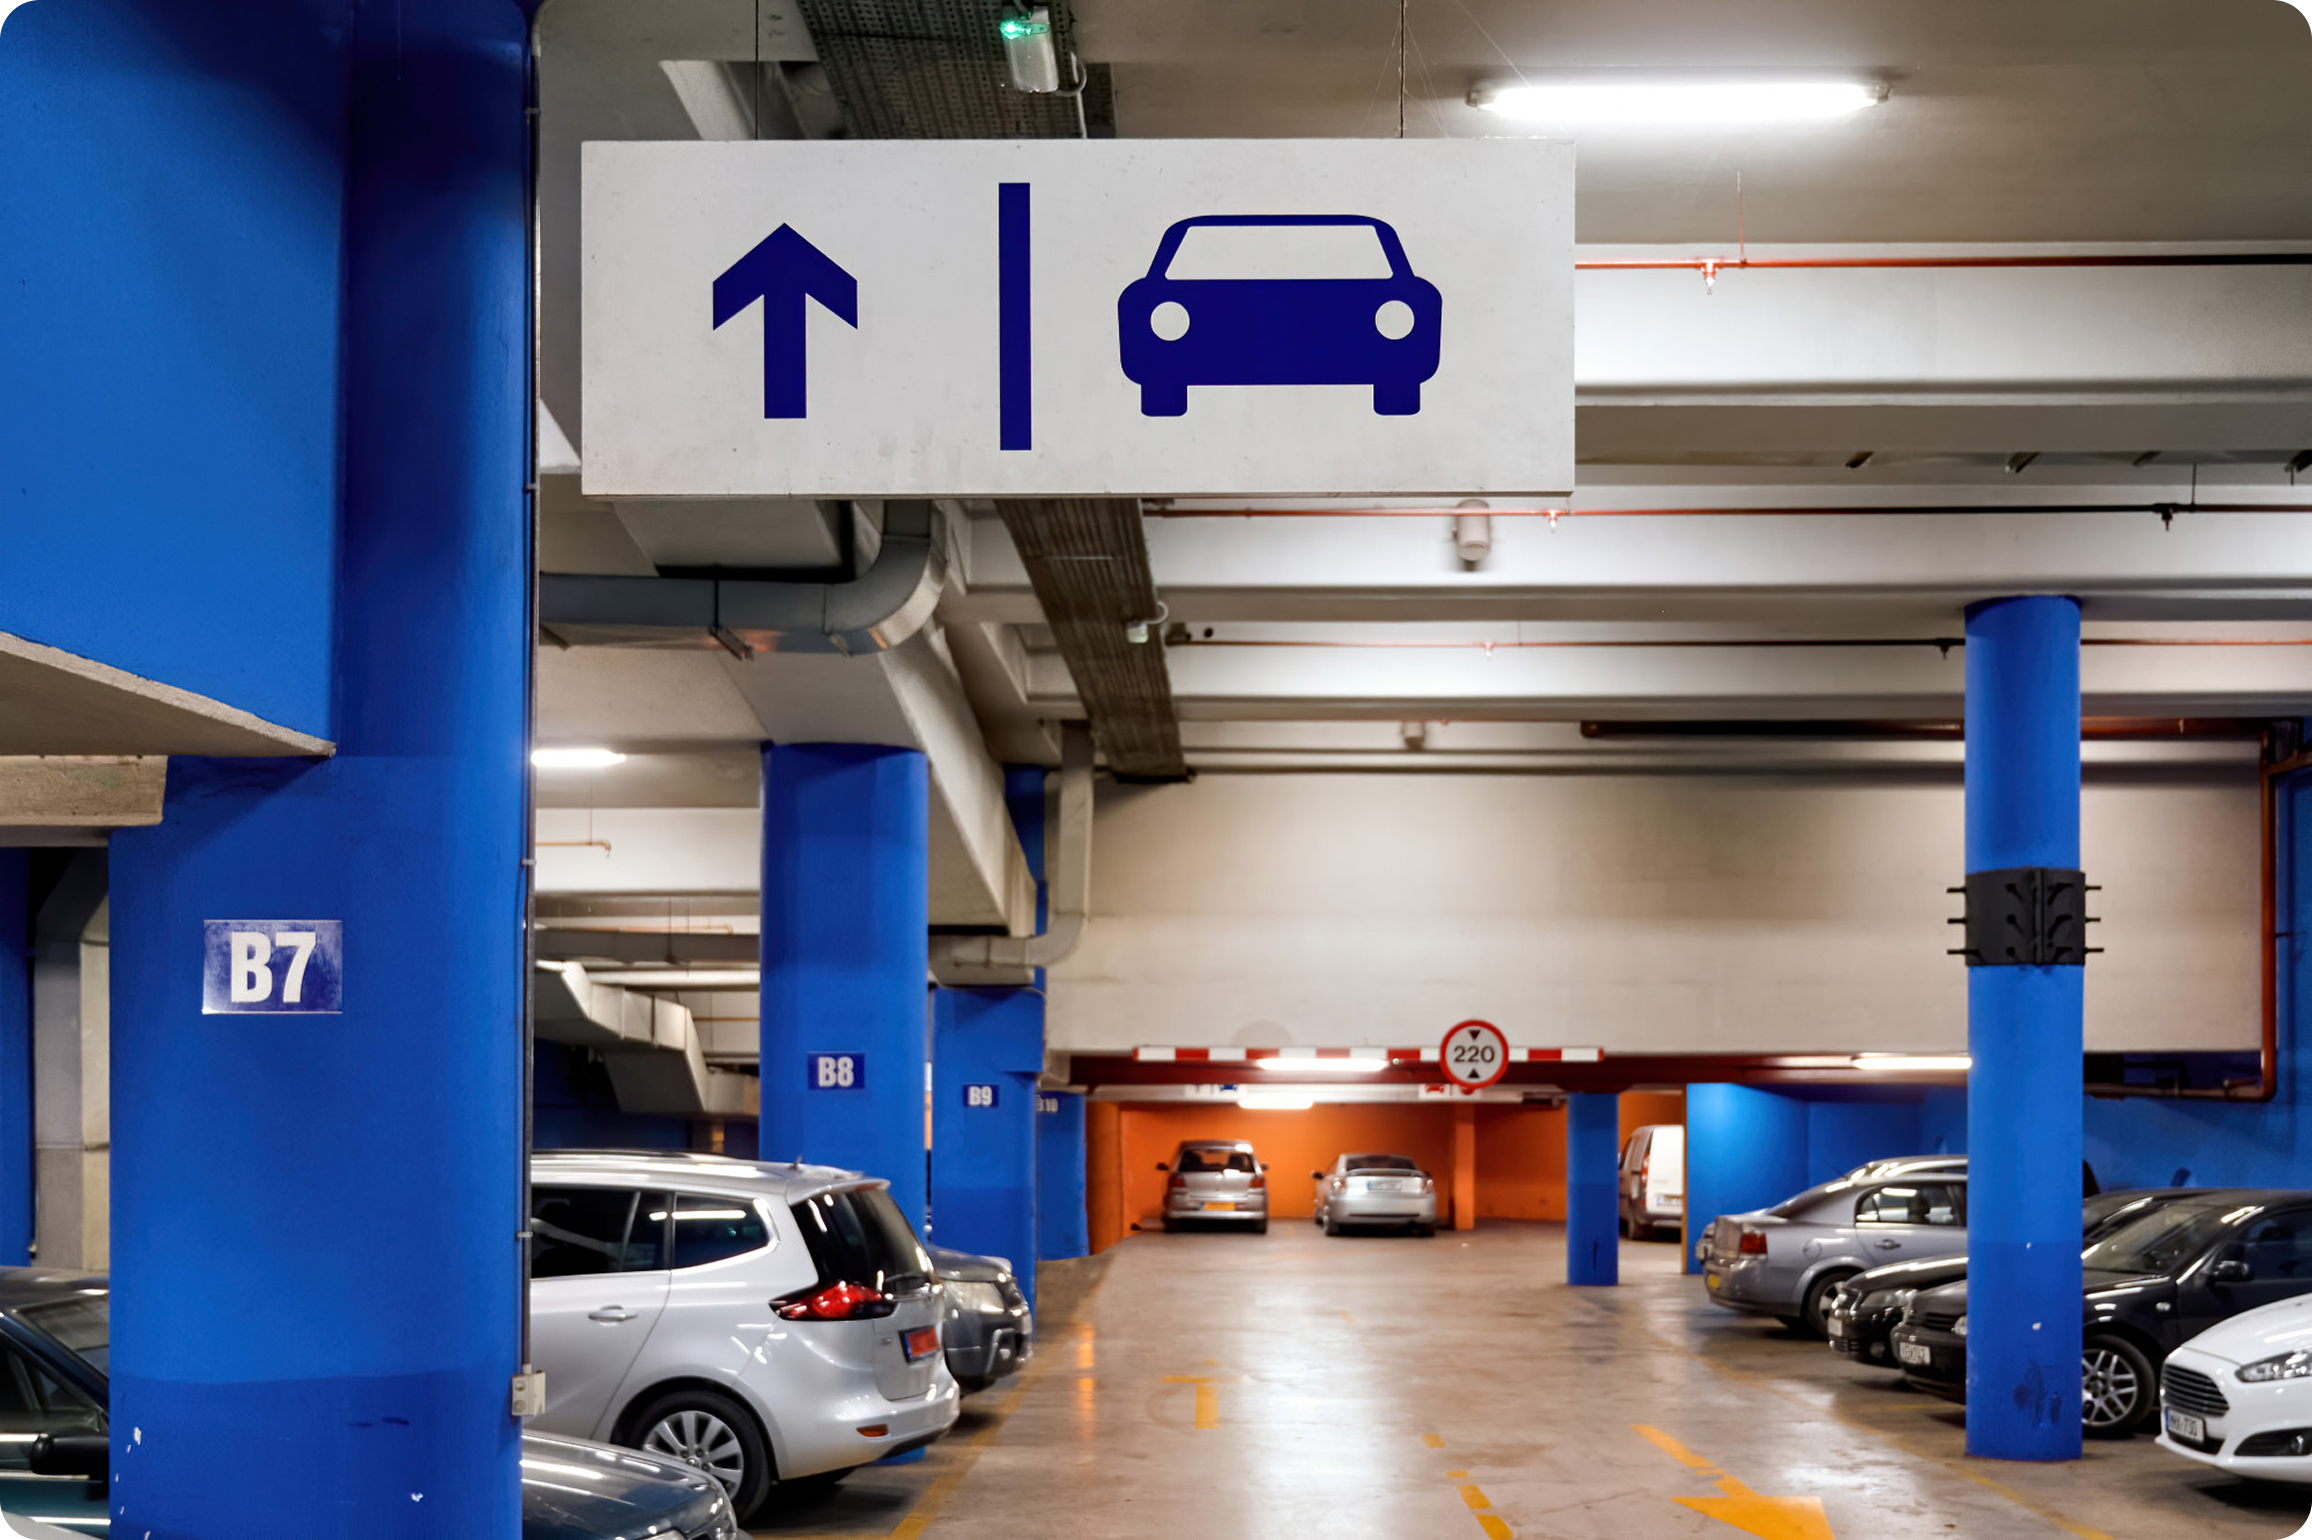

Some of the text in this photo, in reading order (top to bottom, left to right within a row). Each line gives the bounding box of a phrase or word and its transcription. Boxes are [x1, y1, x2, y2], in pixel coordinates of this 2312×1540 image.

[230, 931, 316, 1003] B7
[1453, 1045, 1495, 1063] 220
[818, 1056, 854, 1087] B8
[968, 1085, 993, 1106] B9
